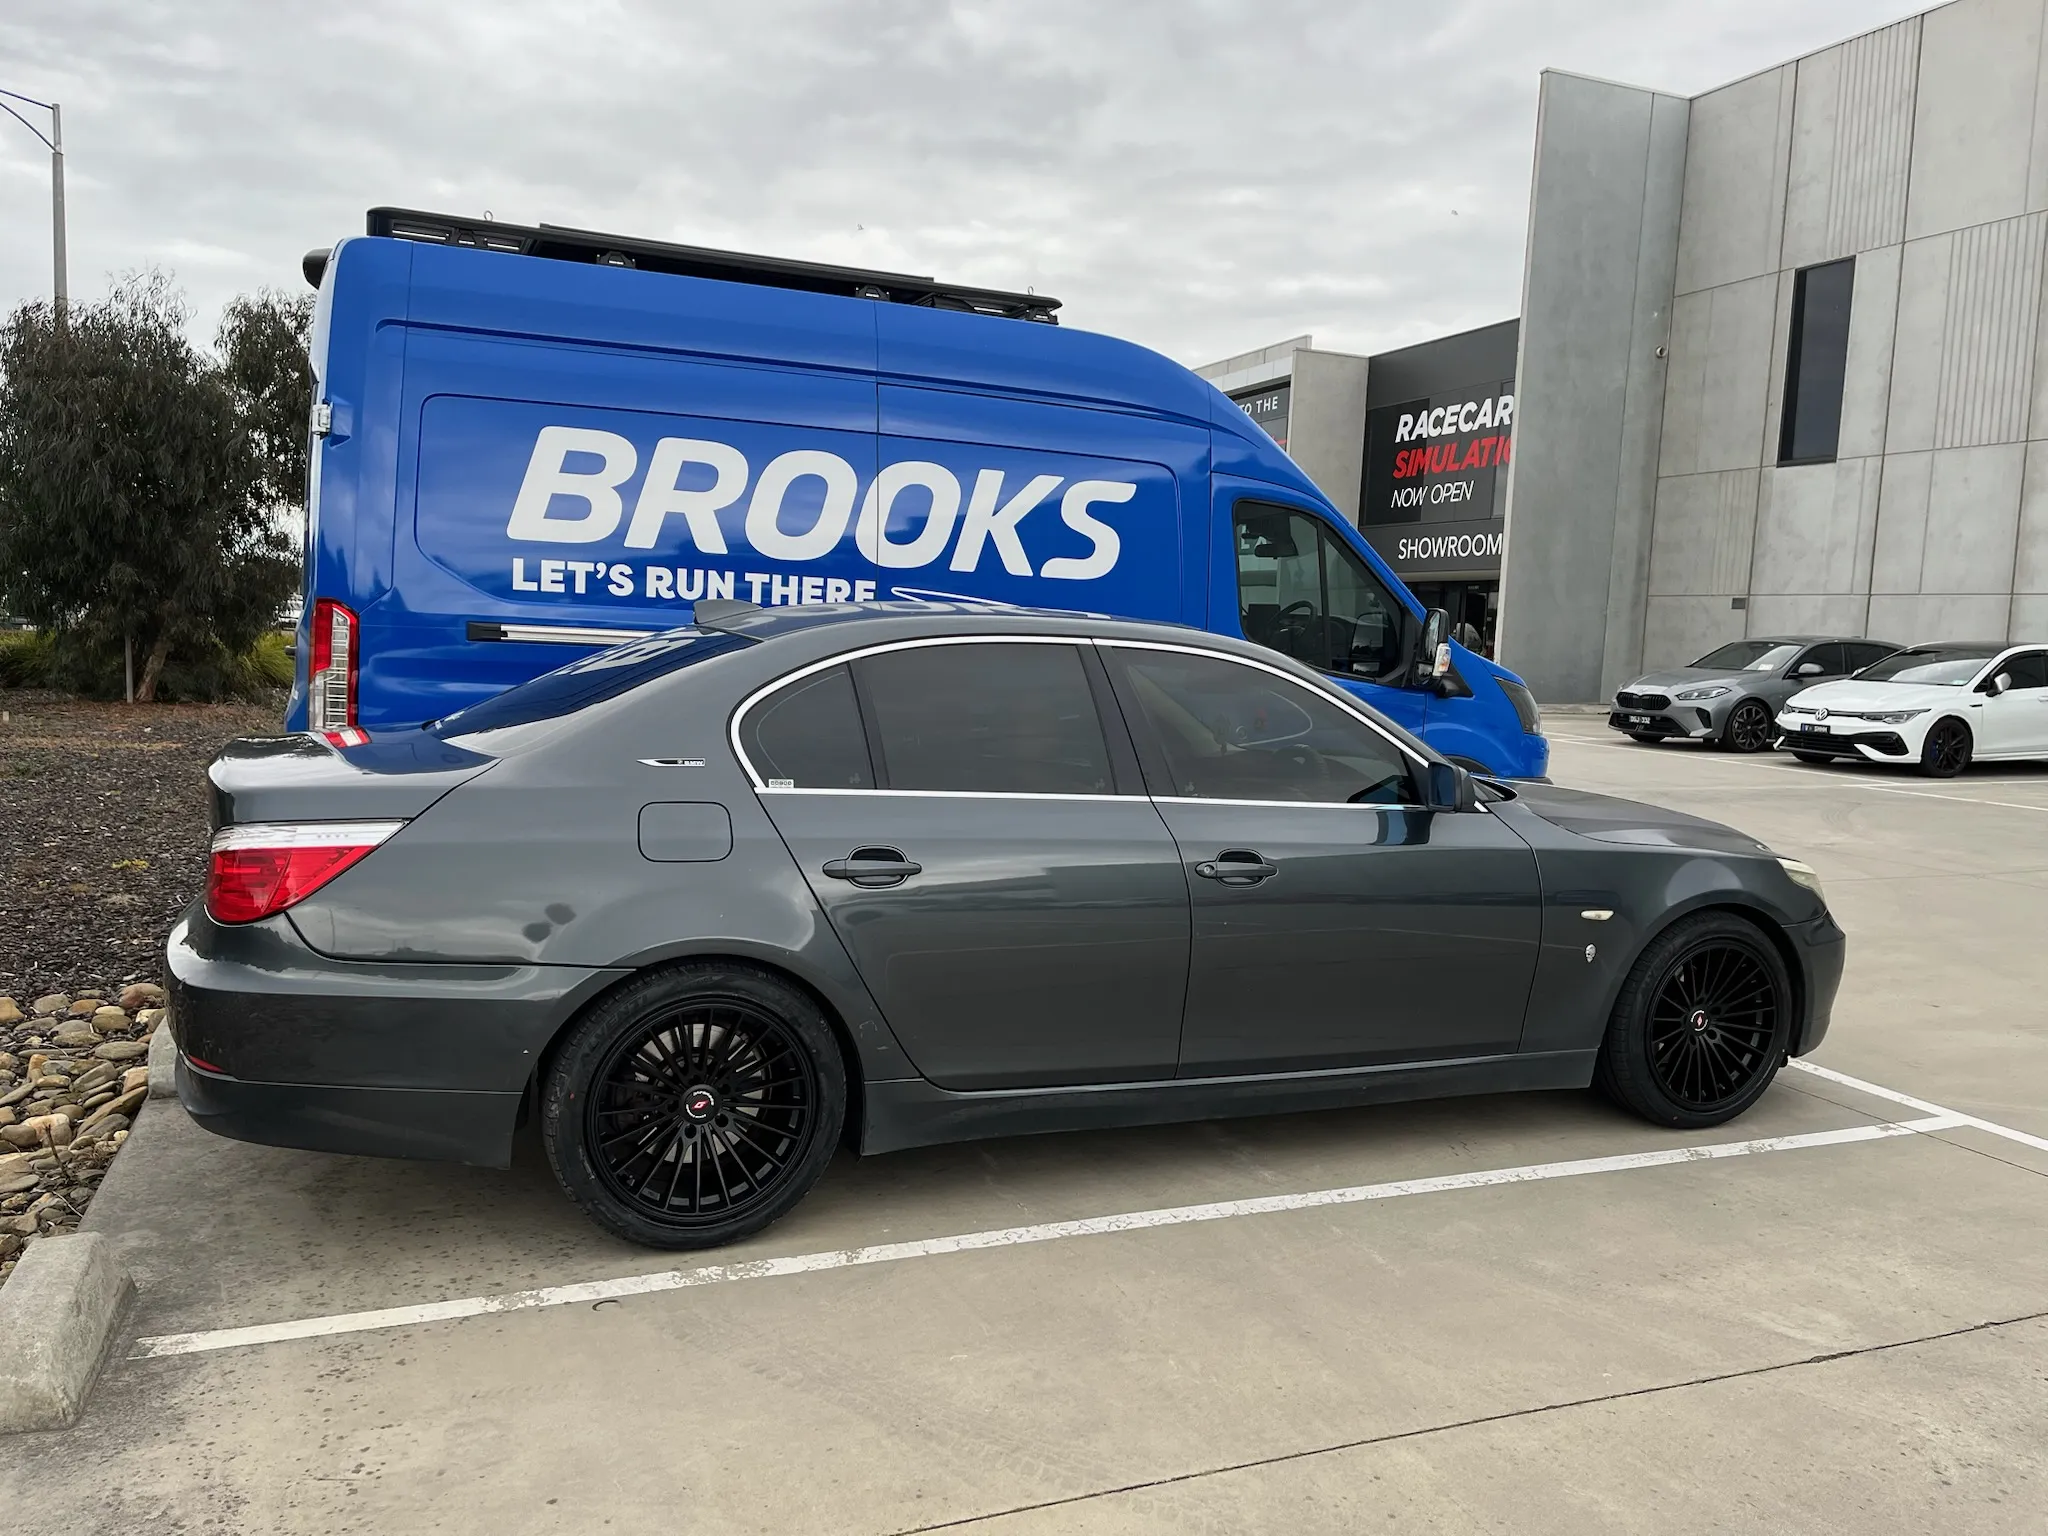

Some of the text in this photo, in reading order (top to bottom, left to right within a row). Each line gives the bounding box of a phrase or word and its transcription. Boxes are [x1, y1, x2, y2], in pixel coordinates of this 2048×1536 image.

[1256, 396, 1278, 413] THE
[1395, 395, 1514, 443] RACECAR
[506, 425, 1137, 580] BROOKS
[1391, 480, 1474, 508] NOW OPEN
[1398, 533, 1502, 559] SHOWROOM
[512, 557, 876, 606] LET'S RUN THERE
